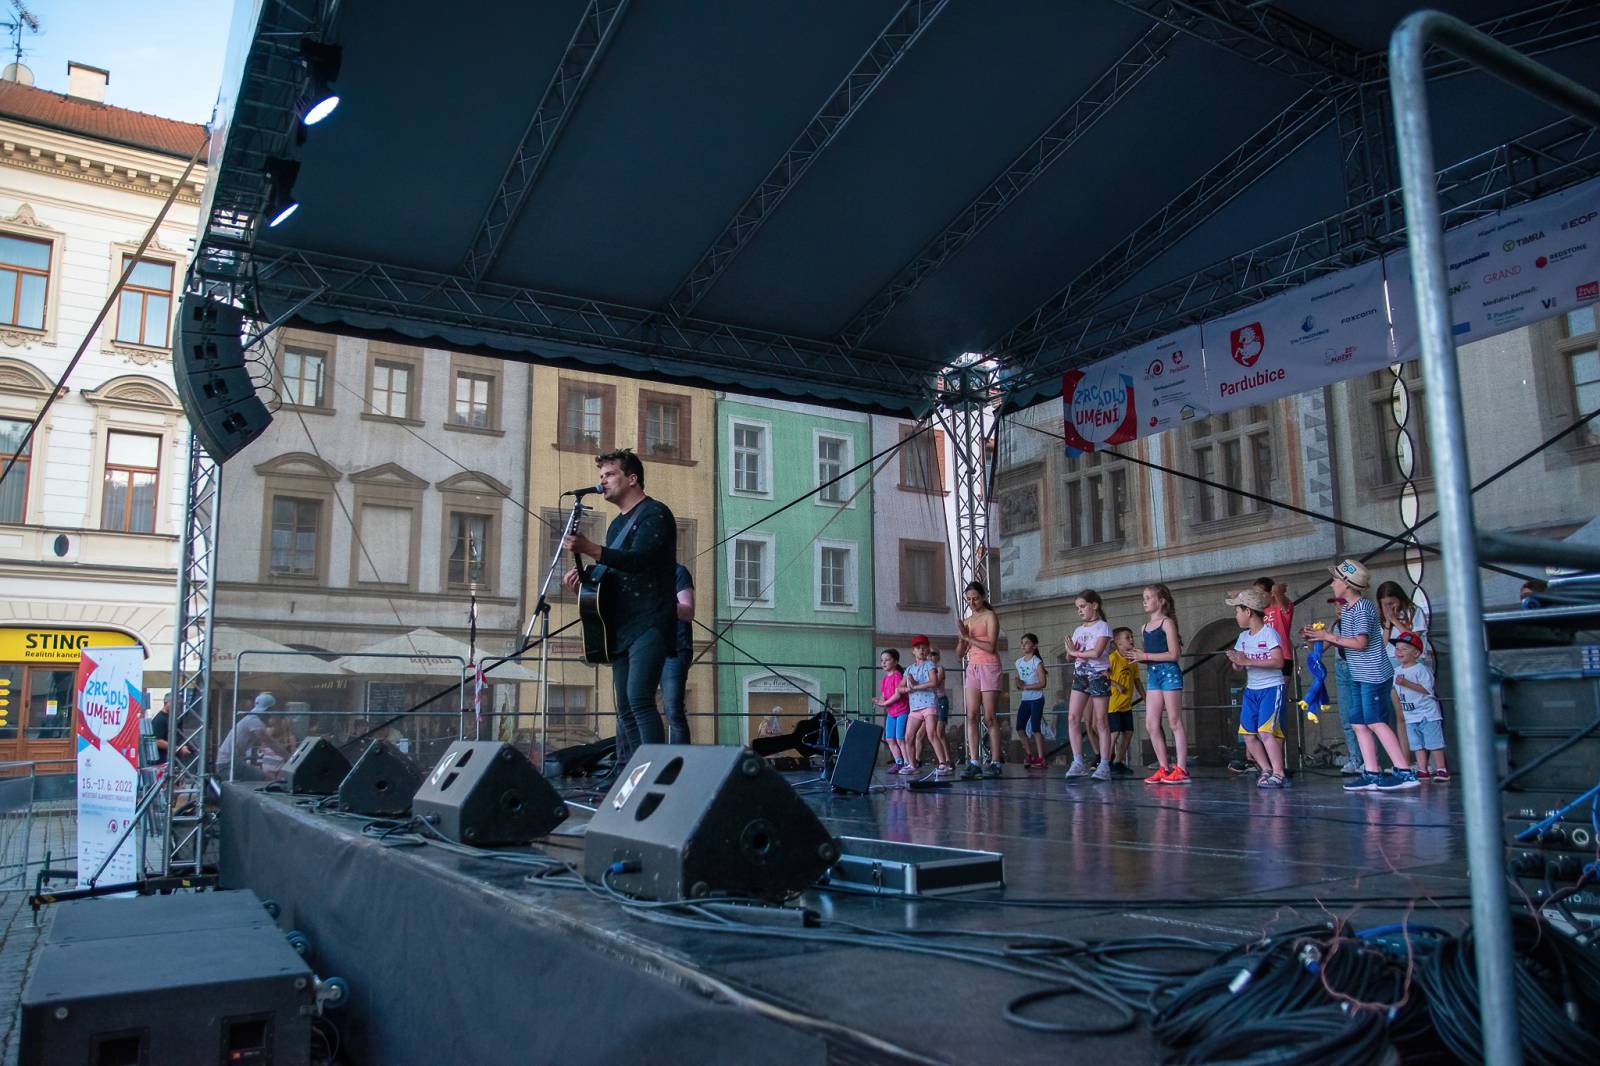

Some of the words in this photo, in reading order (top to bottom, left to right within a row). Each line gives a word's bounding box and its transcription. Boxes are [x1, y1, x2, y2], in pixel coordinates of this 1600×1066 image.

[1483, 265, 1522, 284] GRAND
[1220, 368, 1285, 397] Pardubice
[1076, 405, 1119, 427] UMĚNÍ
[25, 633, 89, 650] STING
[56, 649, 80, 659] kancel
[86, 701, 121, 725] UMĚNÍ
[115, 780, 132, 792] 2022
